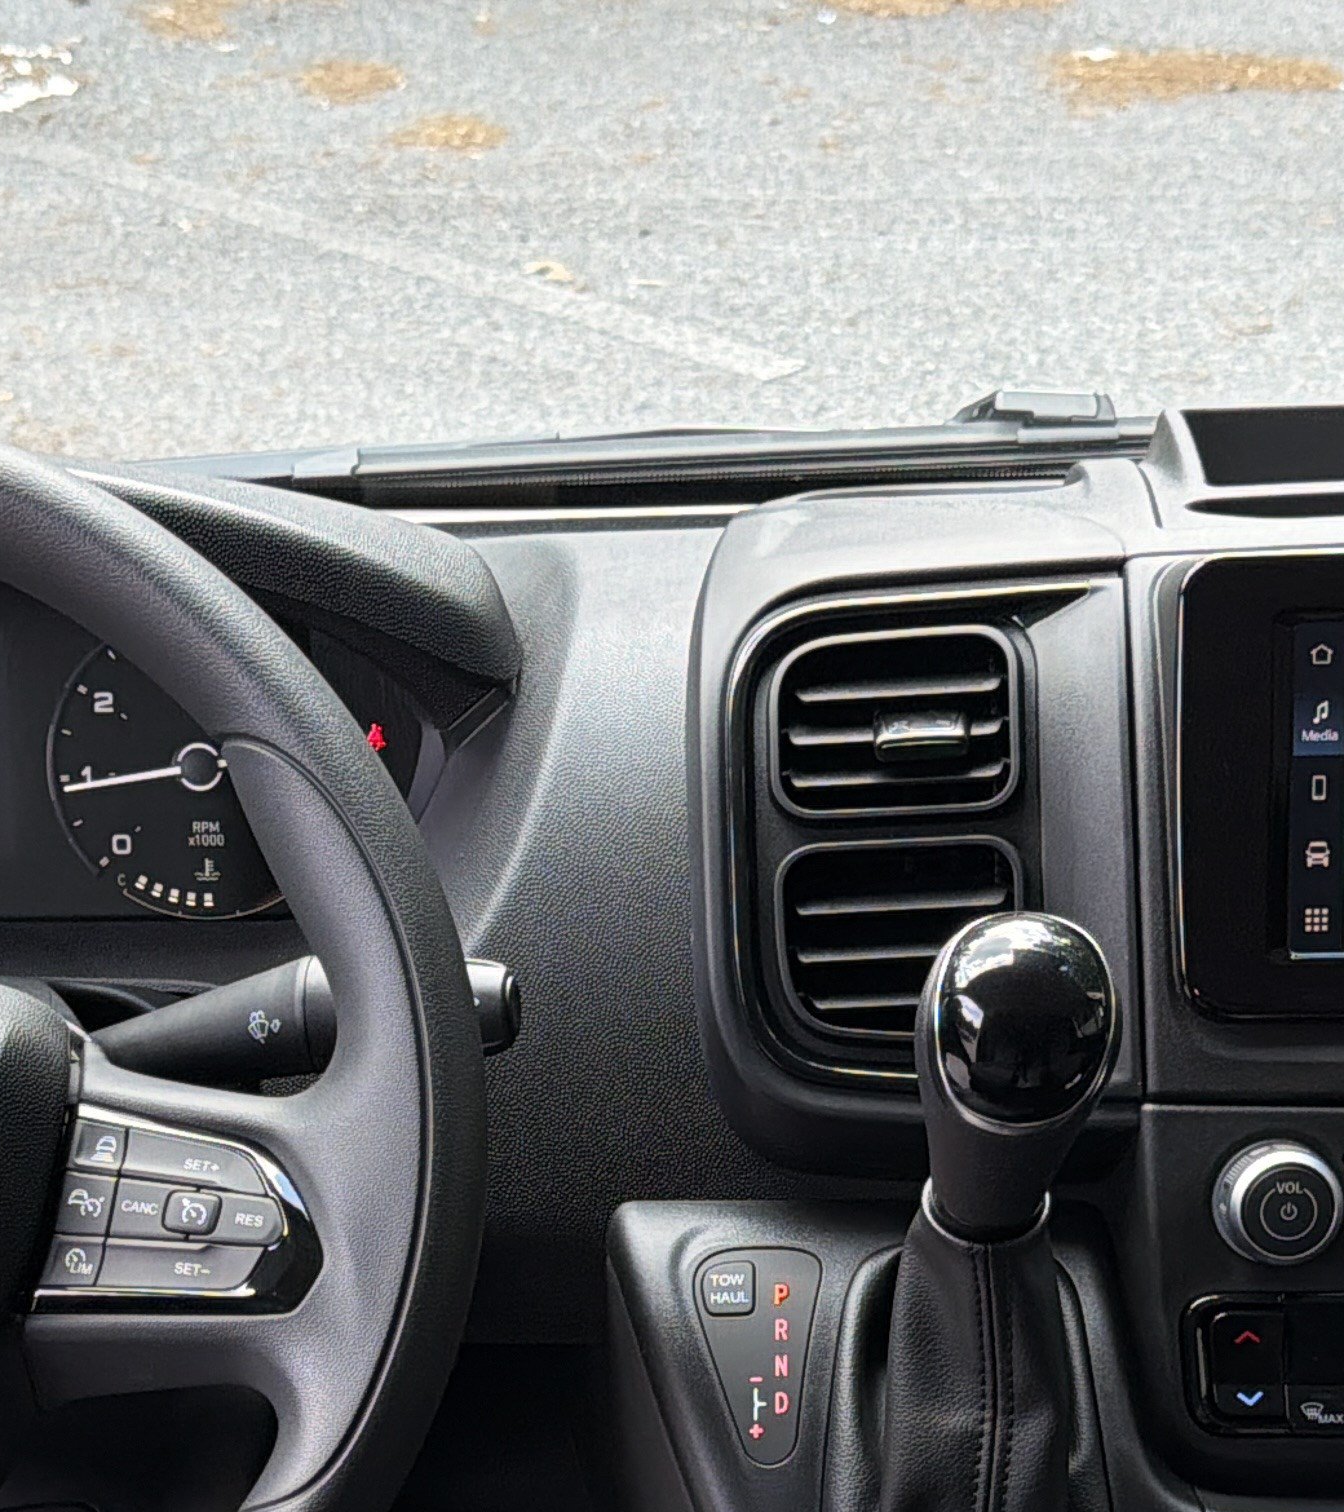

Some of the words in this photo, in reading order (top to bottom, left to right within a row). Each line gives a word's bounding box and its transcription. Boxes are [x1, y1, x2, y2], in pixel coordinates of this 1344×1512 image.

[92, 691, 115, 714] 2
[1301, 728, 1340, 743] Media
[192, 821, 221, 834] RPM
[111, 833, 133, 856] 0
[188, 833, 225, 848] x1000
[117, 873, 127, 887] C
[1275, 1181, 1305, 1195] VOL
[120, 1201, 160, 1216] CANC
[234, 1211, 264, 1228] RES
[69, 1261, 94, 1276] LIM
[709, 1273, 745, 1288] TOW
[709, 1290, 750, 1306] HAUL
[773, 1282, 790, 1306] P
[774, 1317, 789, 1341] R
[774, 1353, 789, 1378] N
[774, 1390, 790, 1415] D
